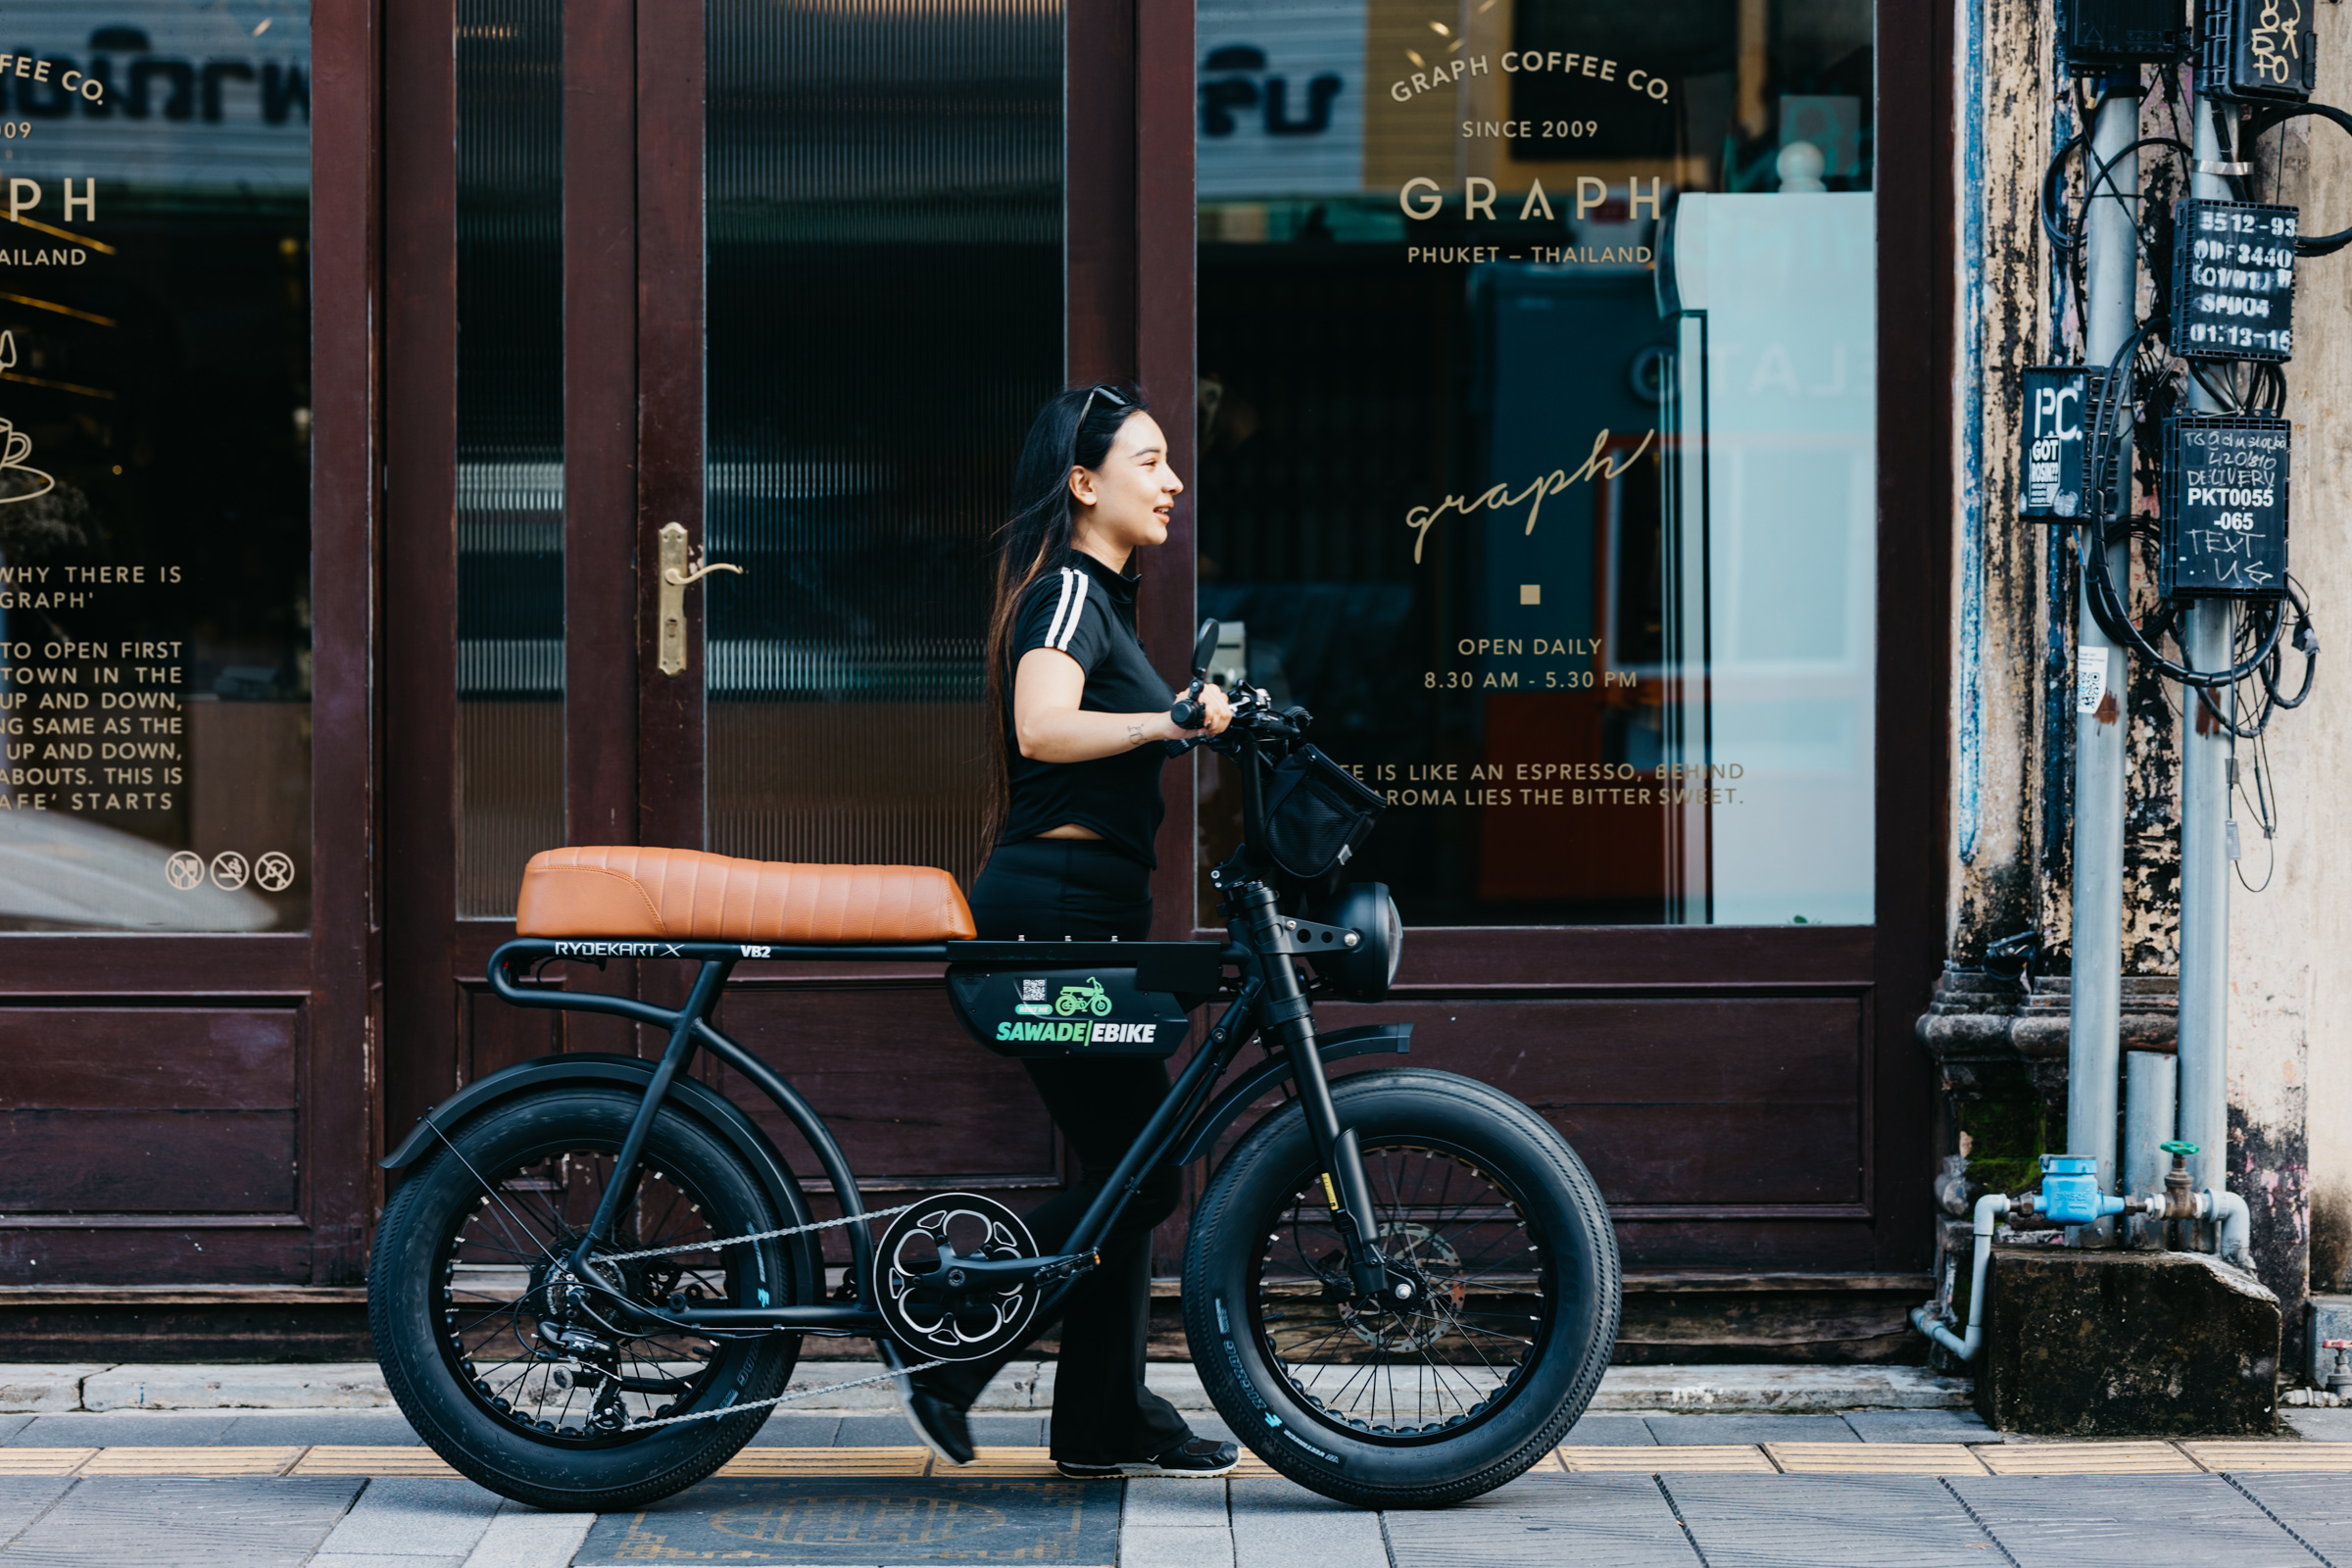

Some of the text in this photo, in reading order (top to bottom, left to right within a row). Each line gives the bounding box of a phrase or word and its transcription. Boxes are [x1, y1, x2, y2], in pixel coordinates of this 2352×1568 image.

[1391, 51, 1669, 104] GRAPH COFFEE CO.
[62, 70, 103, 105] CO.
[0, 122, 31, 139] 09
[1462, 121, 1598, 138] SINCE 2009
[10, 177, 95, 222] PH
[1399, 176, 1660, 220] GRAPH
[0, 249, 86, 266] AILAND
[1407, 247, 1499, 264] PHUKET
[1531, 247, 1651, 264] THAILAND
[2033, 440, 2059, 462] GOT
[2187, 467, 2275, 490] DELIVERY
[1405, 428, 1654, 564] graph
[2187, 488, 2274, 507] PKT0055
[2214, 512, 2254, 530] -065
[2185, 528, 2266, 559] TEXT
[0, 566, 180, 583] WHY THERE IS
[0, 642, 181, 659] TO OPEN FIRST
[1458, 638, 1602, 656] OPEN DAILY
[0, 667, 181, 684] TOWN IN THE
[1425, 672, 1472, 688] 8.30
[1484, 672, 1517, 687] AM
[1546, 671, 1593, 688] 5.30
[1605, 672, 1638, 688] PM
[0, 692, 182, 710] UP AND DOWN,
[33, 717, 94, 734] SAME
[104, 717, 130, 734] AS
[139, 717, 181, 733] THE
[7, 743, 182, 760] UP AND DOWN,
[104, 767, 152, 784] THIS
[165, 767, 182, 784] IS
[1378, 764, 1396, 780] IS
[1410, 764, 1457, 780] LIKE
[1471, 764, 1502, 780] AN
[1516, 763, 1642, 782] ESPRESSO,
[1655, 763, 1744, 780] BEHIND
[72, 793, 172, 810] STARTS
[1374, 787, 1744, 806] ROMA LIES THE BITTER SWEET.
[555, 942, 685, 956] RYDEKART X
[740, 945, 771, 958] VB2
